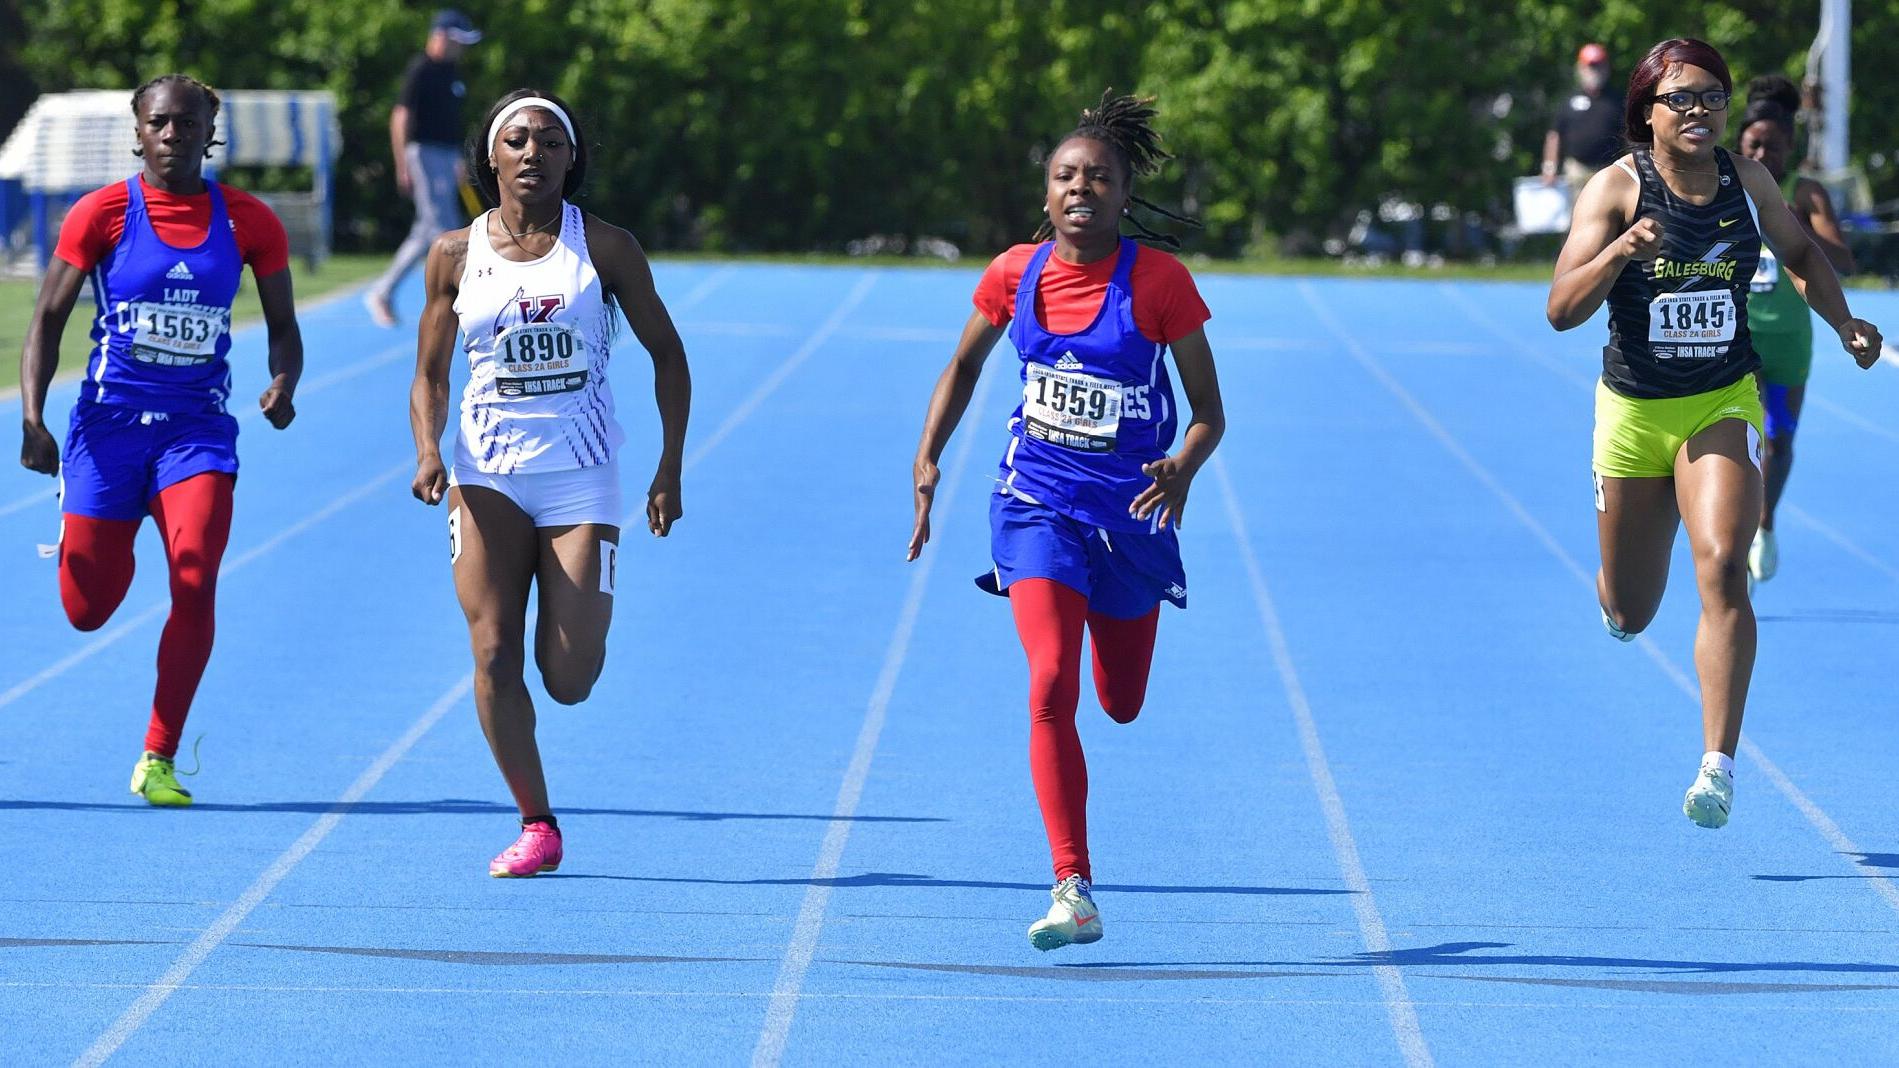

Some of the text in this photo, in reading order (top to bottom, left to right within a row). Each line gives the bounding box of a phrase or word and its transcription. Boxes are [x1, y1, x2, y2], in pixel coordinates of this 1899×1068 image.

[1654, 257, 1737, 281] GALESBURG
[163, 287, 200, 303] LADY
[1659, 301, 1726, 330] 1845
[147, 313, 209, 343] 1563
[1664, 330, 1688, 338] CLASS
[1701, 329, 1722, 338] GIRLS
[503, 332, 573, 364] 1890
[1677, 346, 1693, 358] IHSA
[1694, 346, 1716, 358] TRACK
[508, 361, 570, 373] CLASS 2A GIRLS
[1054, 362, 1084, 370] adidas
[524, 381, 542, 393] IHSA
[541, 378, 567, 392] TRACK
[1035, 376, 1107, 421] 1559
[1038, 408, 1098, 429] CLASS 2A GIRLS
[1048, 429, 1065, 445] IHSA
[1065, 433, 1090, 449] TRACK
